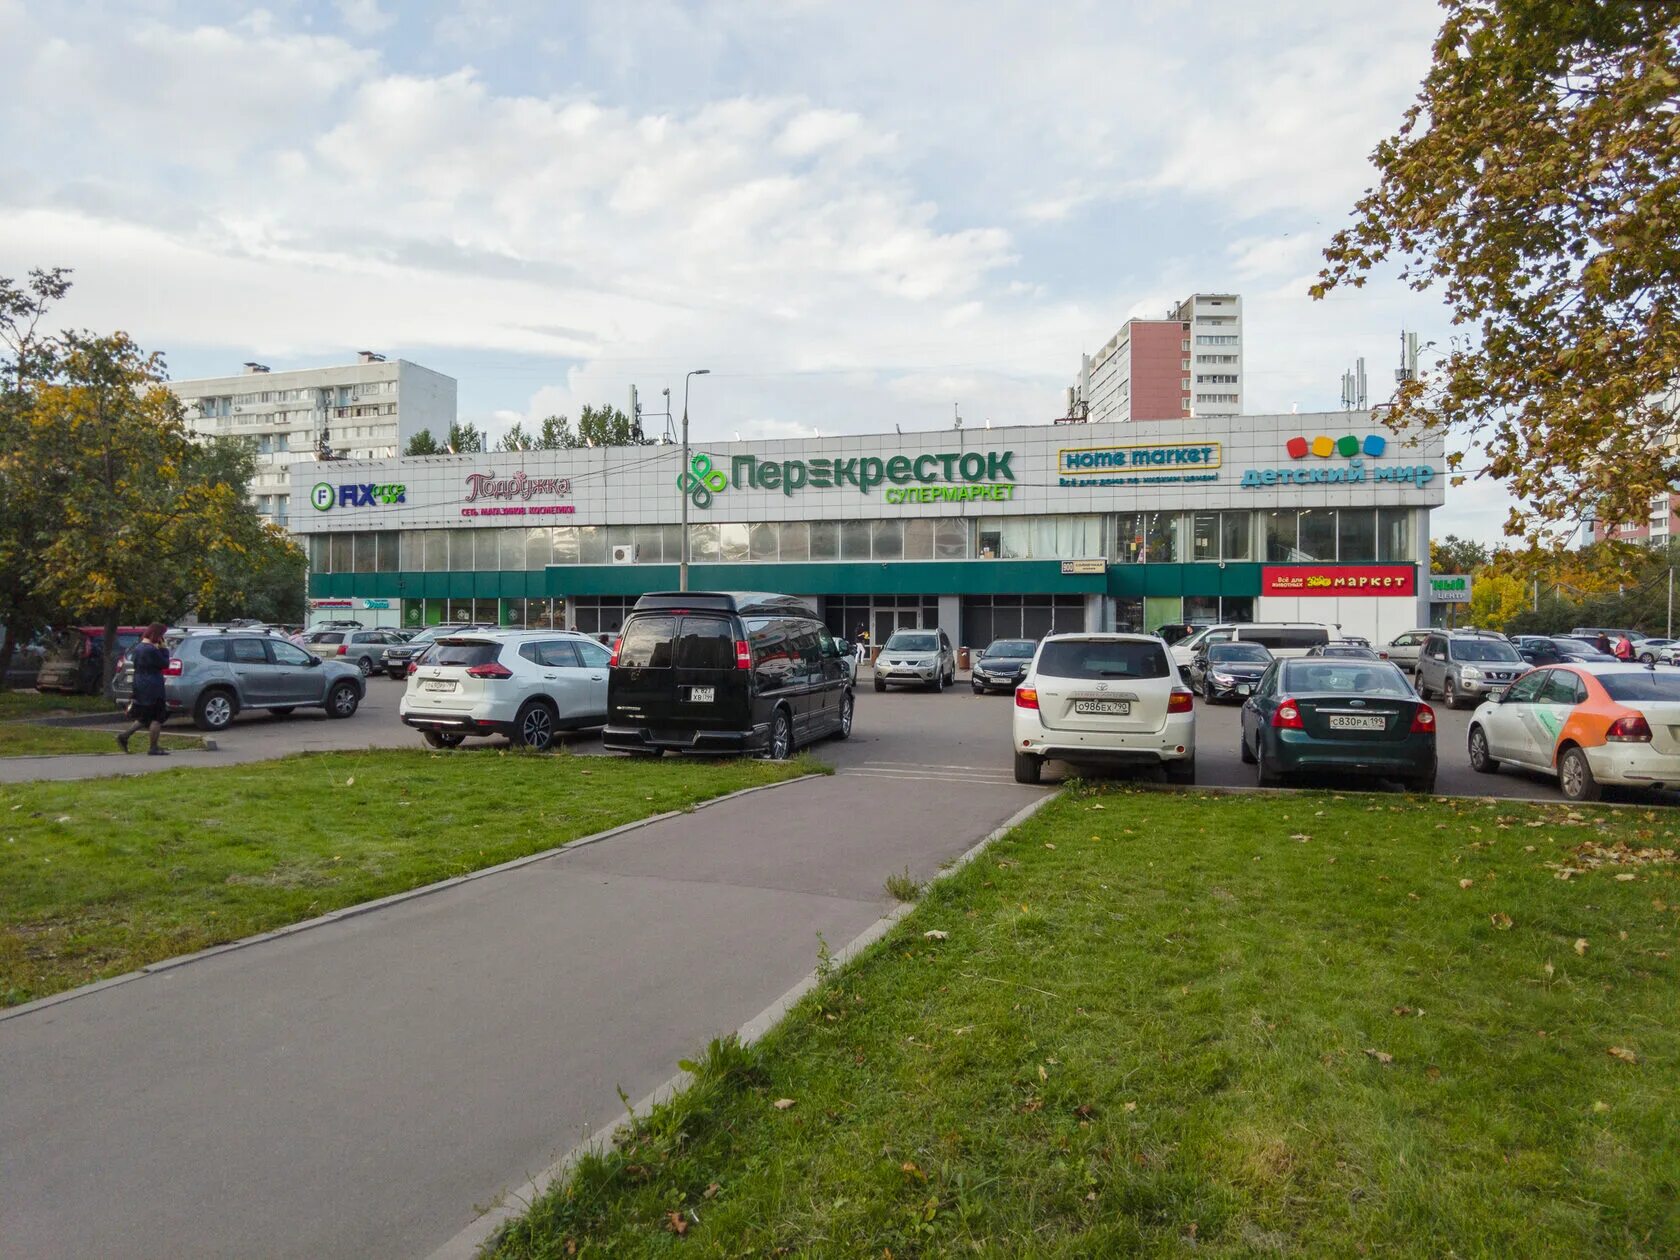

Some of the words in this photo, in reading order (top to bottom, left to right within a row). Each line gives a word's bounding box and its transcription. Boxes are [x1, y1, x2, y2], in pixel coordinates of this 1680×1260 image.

[731, 451, 1015, 496] Перекресток
[1241, 459, 1366, 489] детский
[1373, 461, 1436, 489] мир
[338, 483, 377, 508] FIX
[371, 483, 407, 498] price
[464, 470, 573, 503] Подружка
[885, 482, 1015, 504] СУПЕРМАРКЕТ
[460, 508, 479, 517] СЕТЬ
[1334, 576, 1406, 588] маркет
[1430, 577, 1466, 591] НЫЙ
